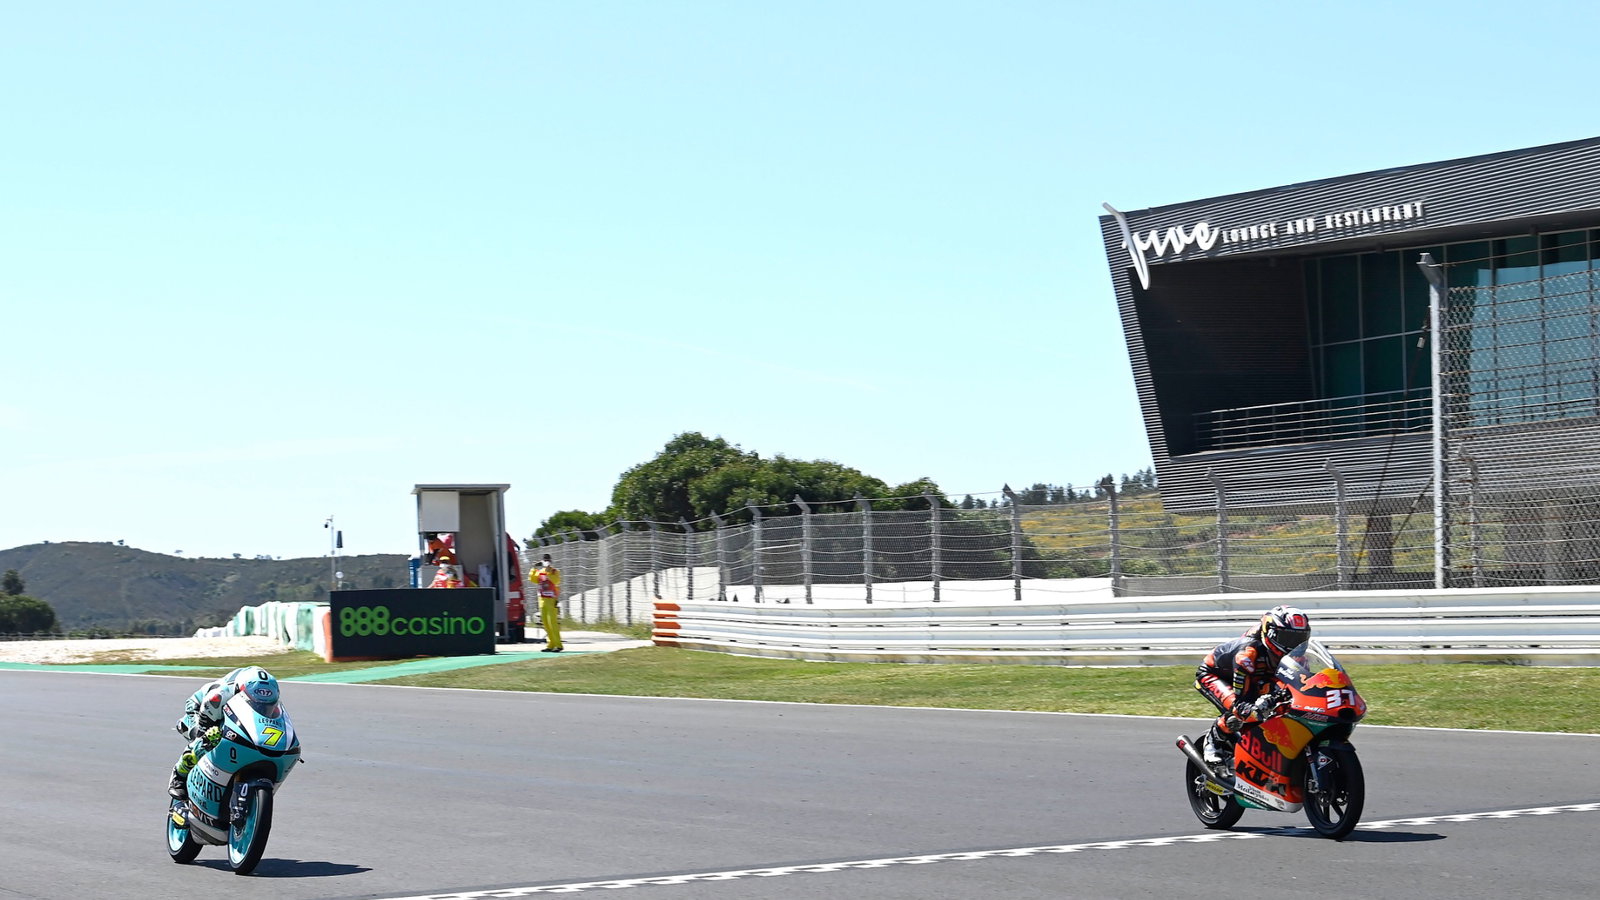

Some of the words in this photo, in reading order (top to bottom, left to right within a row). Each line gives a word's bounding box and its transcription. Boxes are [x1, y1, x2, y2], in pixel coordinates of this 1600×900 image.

[1222, 222, 1278, 244] LOUNGE
[1286, 217, 1316, 235] AND
[1325, 202, 1425, 230] RESTAURANT
[339, 606, 485, 637] 888casino
[1326, 689, 1356, 710] 37
[262, 727, 284, 747] 7
[1251, 737, 1283, 774] Bull
